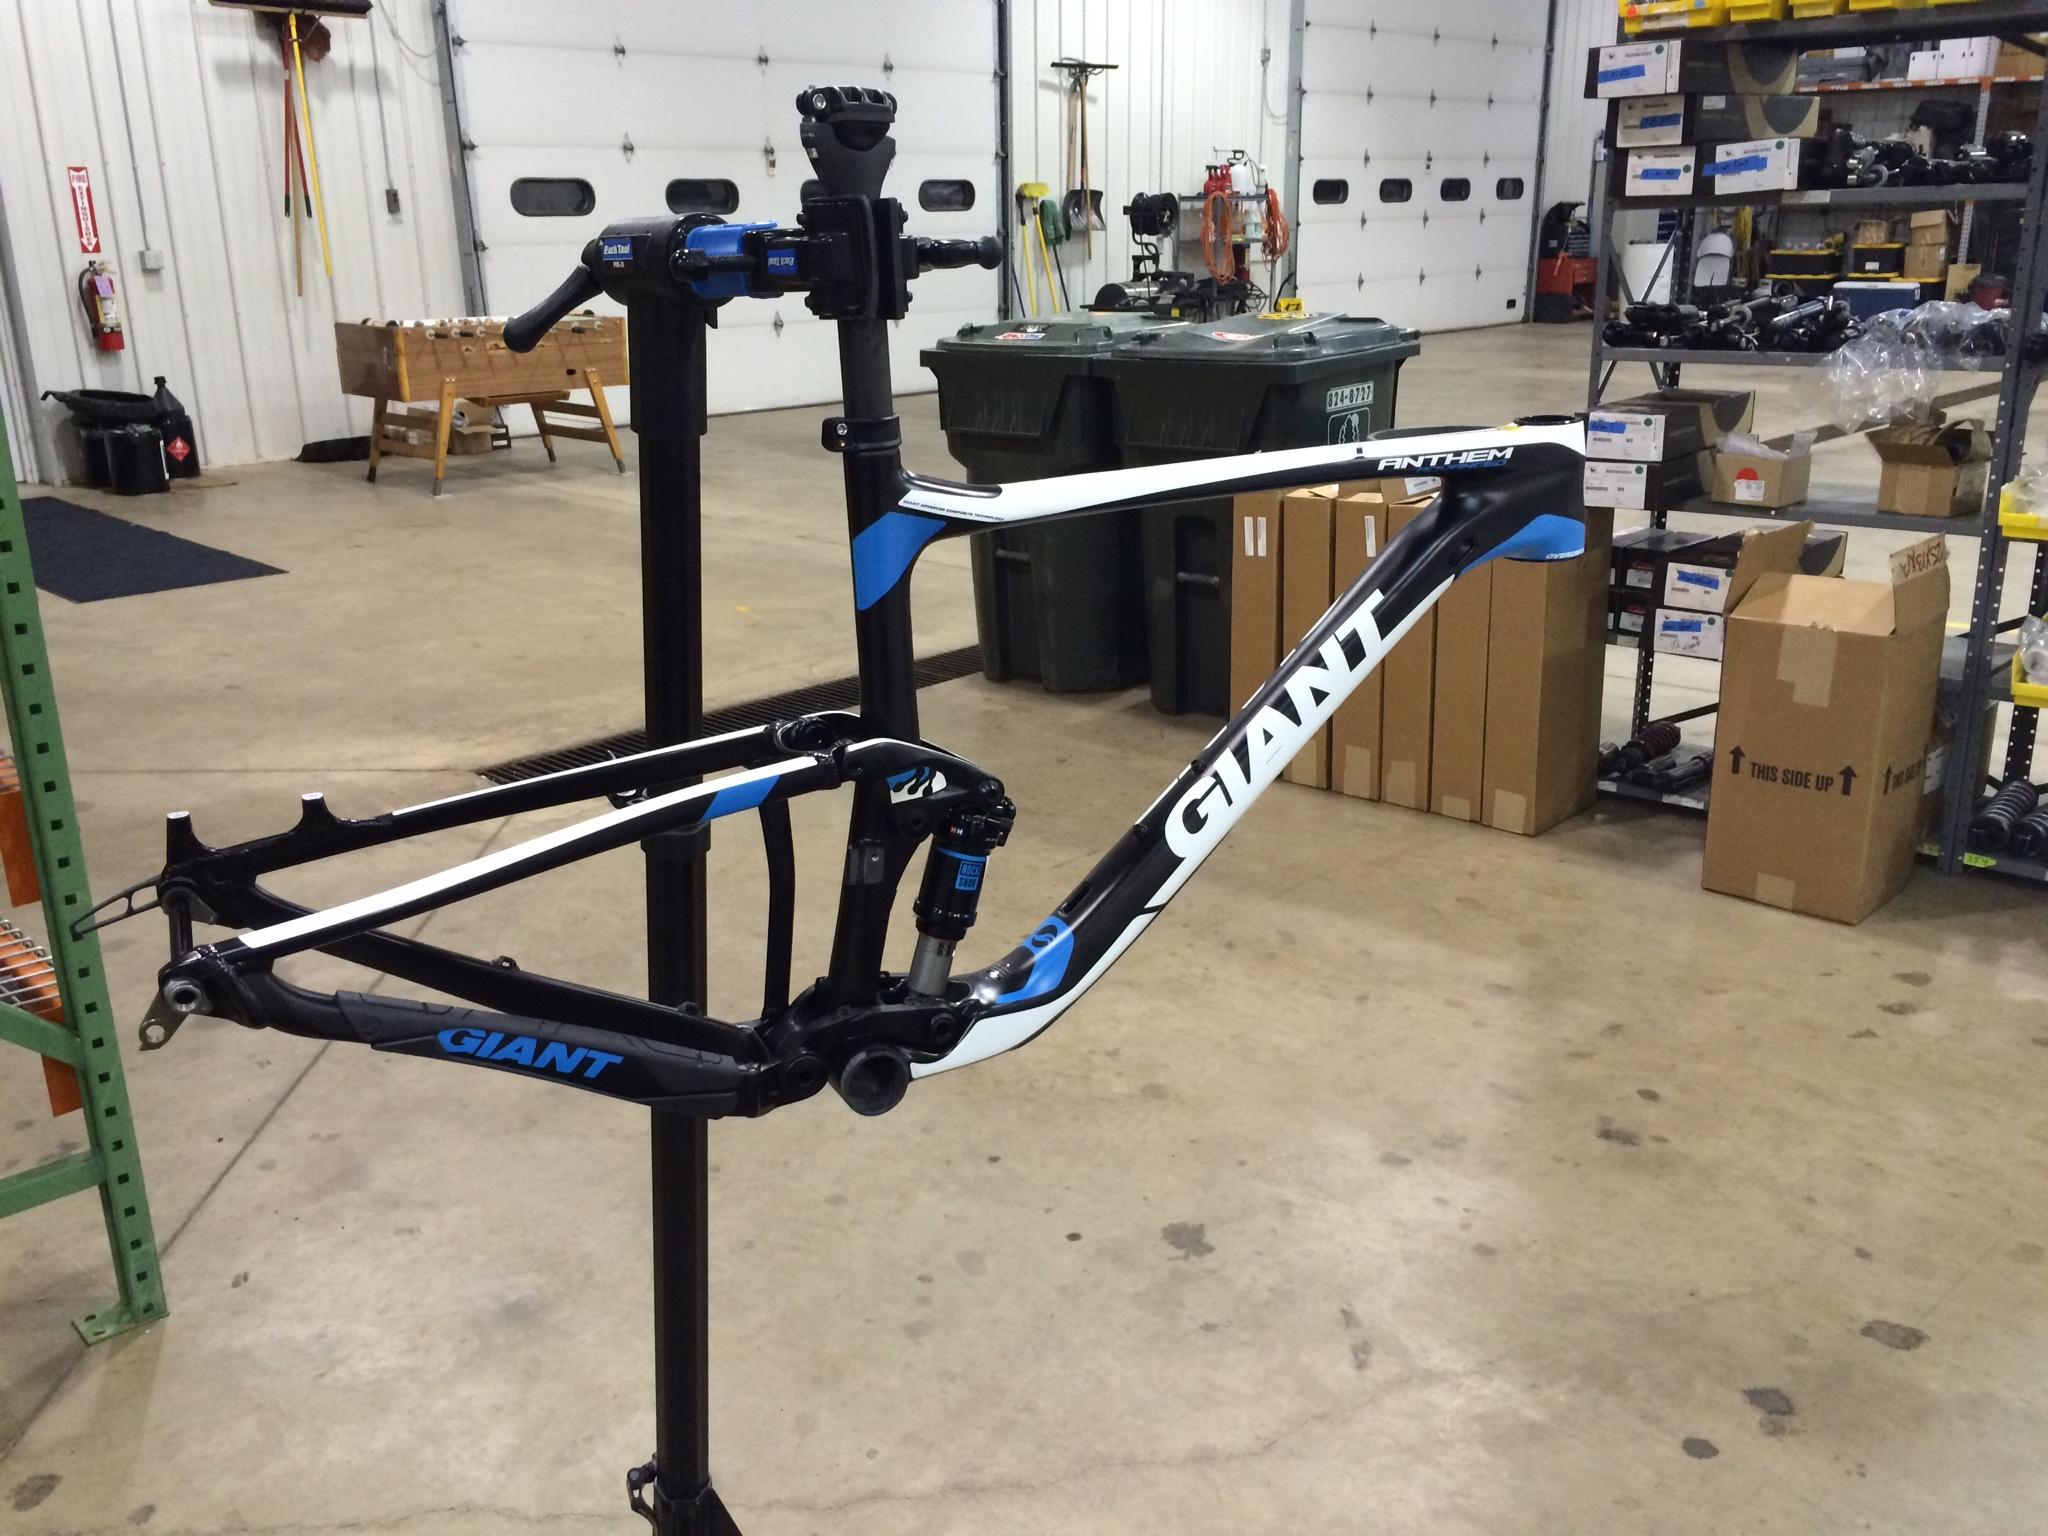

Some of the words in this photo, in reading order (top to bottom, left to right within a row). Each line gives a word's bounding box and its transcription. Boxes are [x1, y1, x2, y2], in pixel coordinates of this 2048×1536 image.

[78, 185, 92, 246] EXTINGUISHER
[1328, 385, 1371, 408] 824-8727
[1377, 447, 1514, 470] ANTHEM
[1165, 588, 1385, 858] GIANT
[1751, 762, 1778, 782] THIS
[1782, 768, 1812, 789] SIDE
[1815, 774, 1834, 793] UP
[437, 1027, 624, 1079] GIANT
